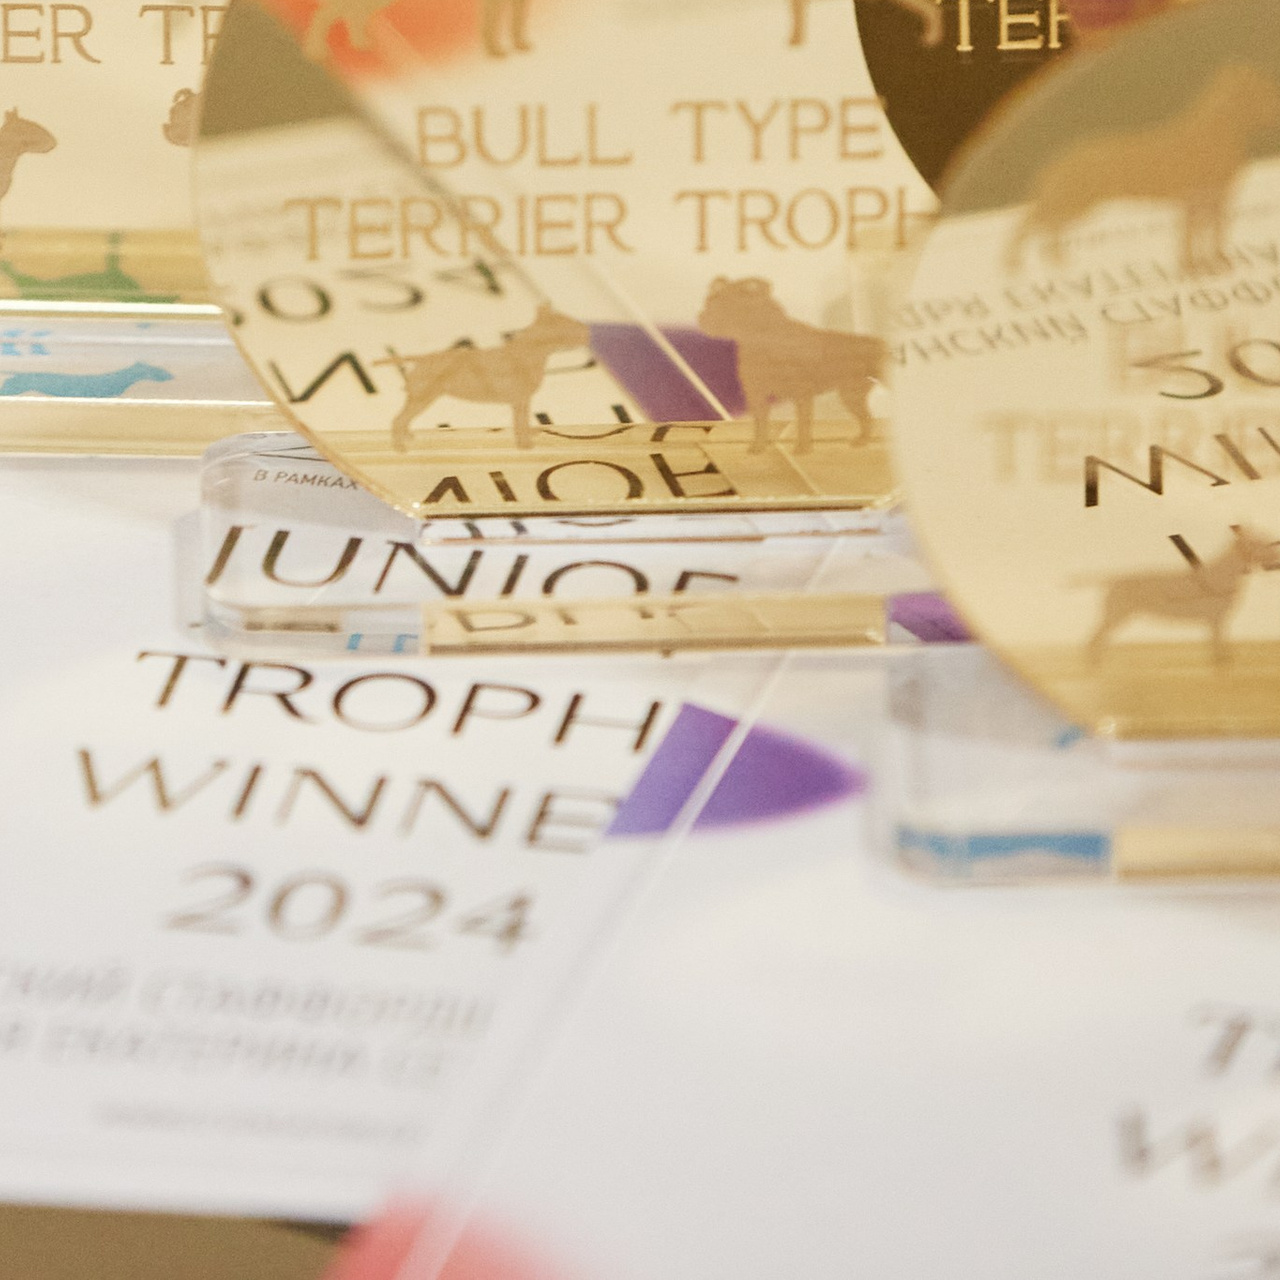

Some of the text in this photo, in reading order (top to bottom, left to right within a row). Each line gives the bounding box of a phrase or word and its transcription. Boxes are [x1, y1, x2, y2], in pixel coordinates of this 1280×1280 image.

[417, 95, 886, 170] BULL TYPE
[282, 190, 637, 262] TERRIER
[136, 651, 663, 754] TROPH
[160, 862, 535, 956] 2024
